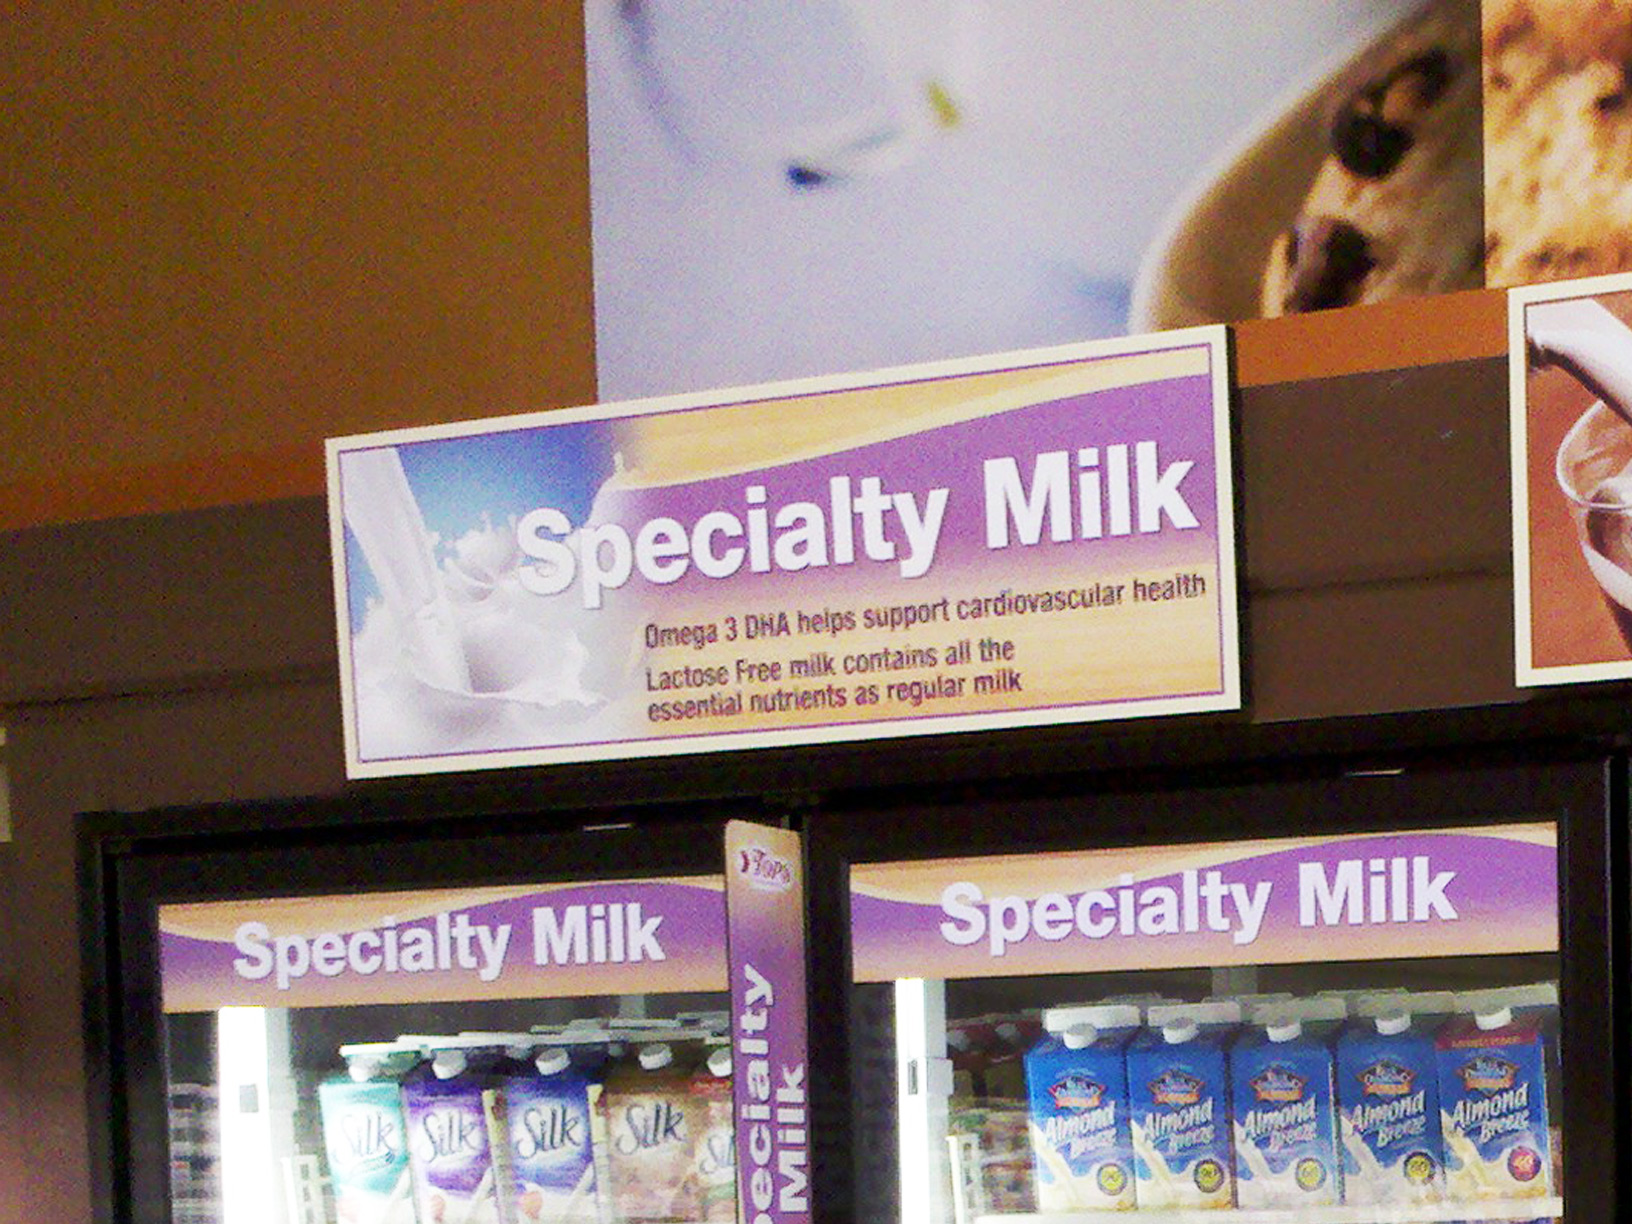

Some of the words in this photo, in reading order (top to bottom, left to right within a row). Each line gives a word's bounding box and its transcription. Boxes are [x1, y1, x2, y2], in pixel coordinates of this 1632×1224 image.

[515, 475, 950, 609] Specialty
[984, 440, 1199, 550] Milk
[645, 620, 717, 649] Omega
[725, 618, 738, 642] 3
[746, 611, 791, 640] DHA
[797, 606, 856, 637] helps
[863, 598, 950, 632] support
[955, 581, 1123, 620] cardiovascular
[1132, 573, 1208, 602] health
[646, 661, 728, 692] Lactose
[736, 657, 781, 682] Free
[789, 651, 835, 679] milk
[842, 645, 938, 675] contains
[945, 639, 971, 667] all
[980, 637, 1015, 663] the
[648, 691, 742, 722] essential
[750, 684, 847, 714] nutrients
[854, 684, 880, 704] as
[886, 673, 965, 704] regular
[973, 669, 1022, 695] milk
[939, 870, 1272, 957] Specialty
[1299, 856, 1458, 928] Milk
[233, 911, 512, 990] Specialty
[532, 903, 666, 966] Milk
[516, 1104, 584, 1158] Silk
[615, 1101, 684, 1154] Silk
[1044, 1100, 1117, 1143] Almond
[1143, 1096, 1213, 1144] Almond
[1243, 1094, 1316, 1140] Almond
[1351, 1089, 1425, 1134] Almond
[1453, 1082, 1529, 1131] Almond
[421, 1106, 480, 1162] Silk
[776, 1063, 807, 1213] Milk
